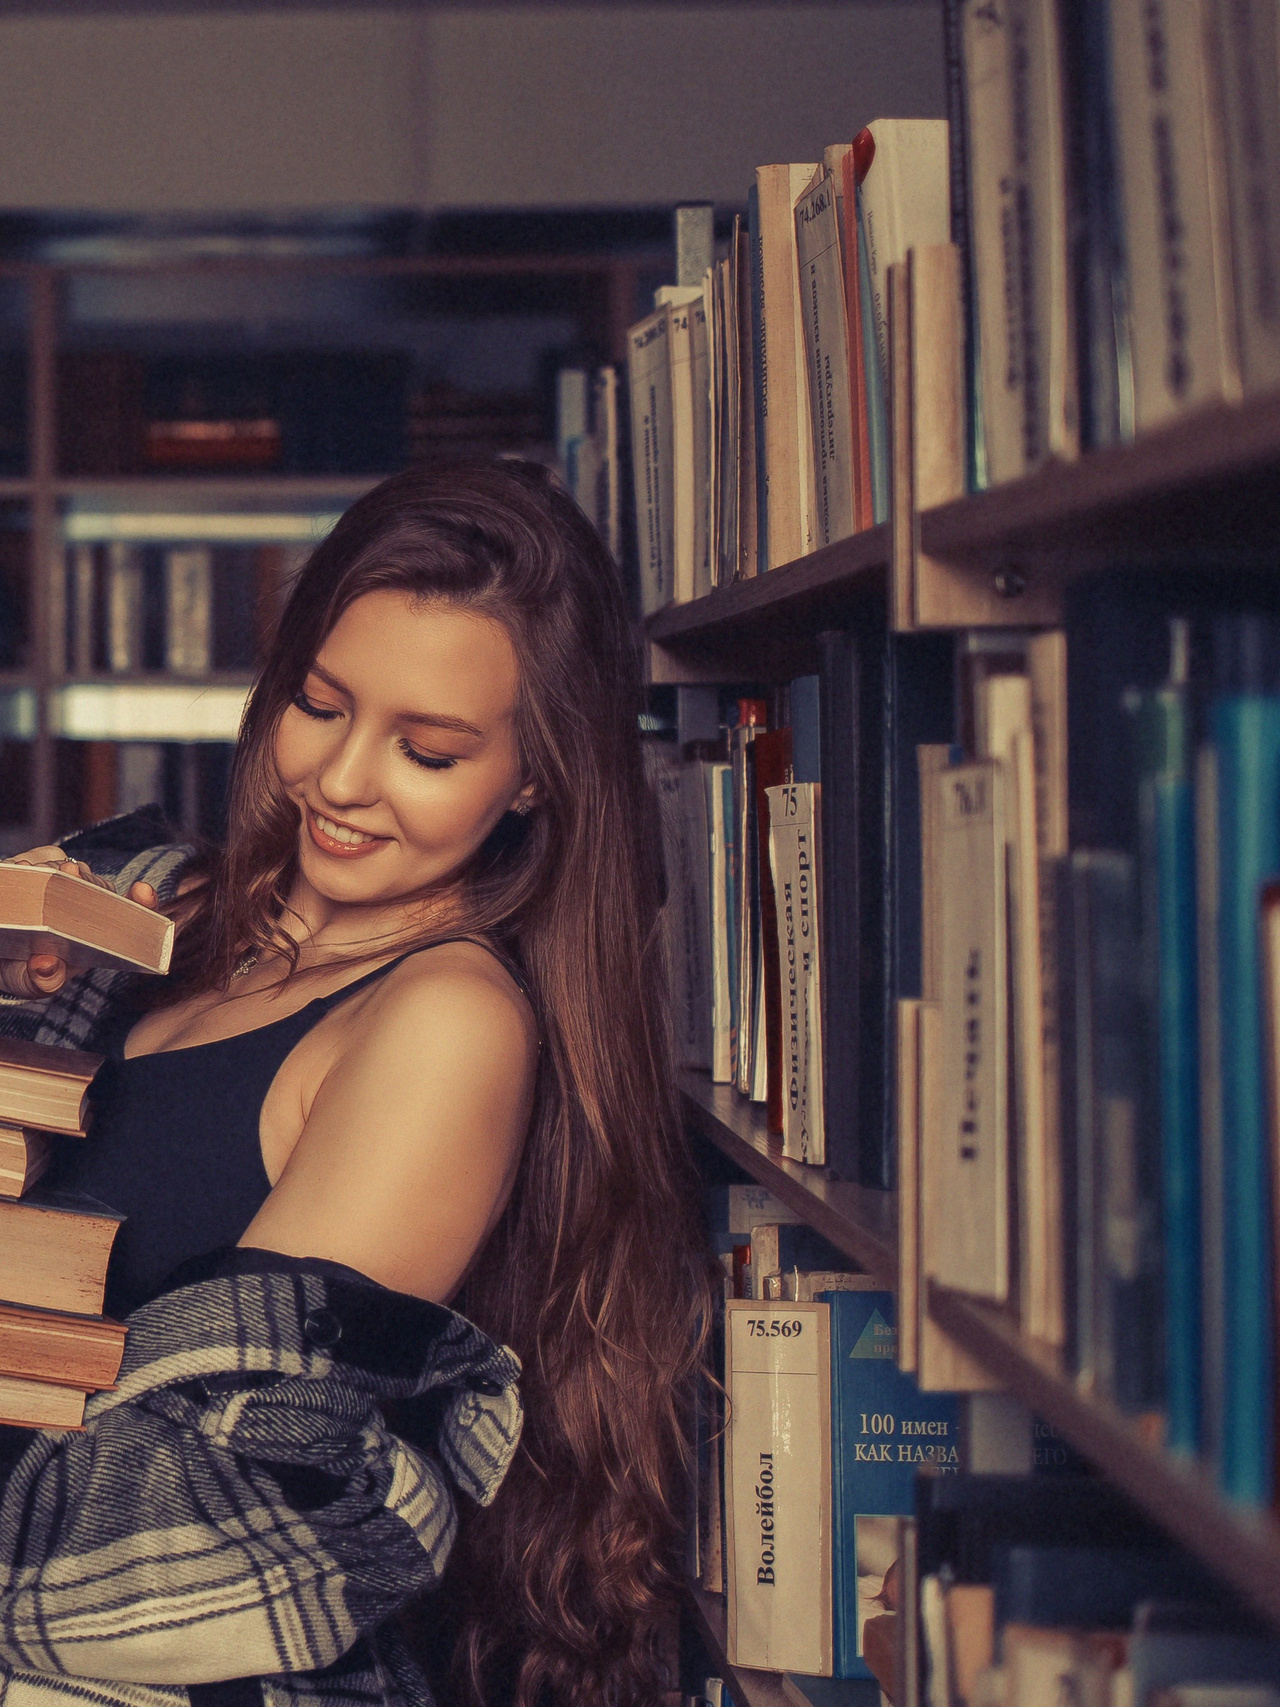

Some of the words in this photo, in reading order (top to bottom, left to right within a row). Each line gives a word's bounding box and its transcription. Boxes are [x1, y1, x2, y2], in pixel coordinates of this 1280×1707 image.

[798, 188, 832, 229] 74.268.1
[824, 354, 835, 461] литературы
[781, 786, 798, 817] 75
[796, 828, 811, 938] спорт
[802, 951, 810, 972] и
[784, 882, 799, 1112] Физическая
[747, 1319, 803, 1338] 75.569
[859, 1413, 895, 1435] 100
[901, 1420, 949, 1436] имен
[854, 1443, 893, 1462] КАК
[755, 1451, 775, 1588] Волейбол
